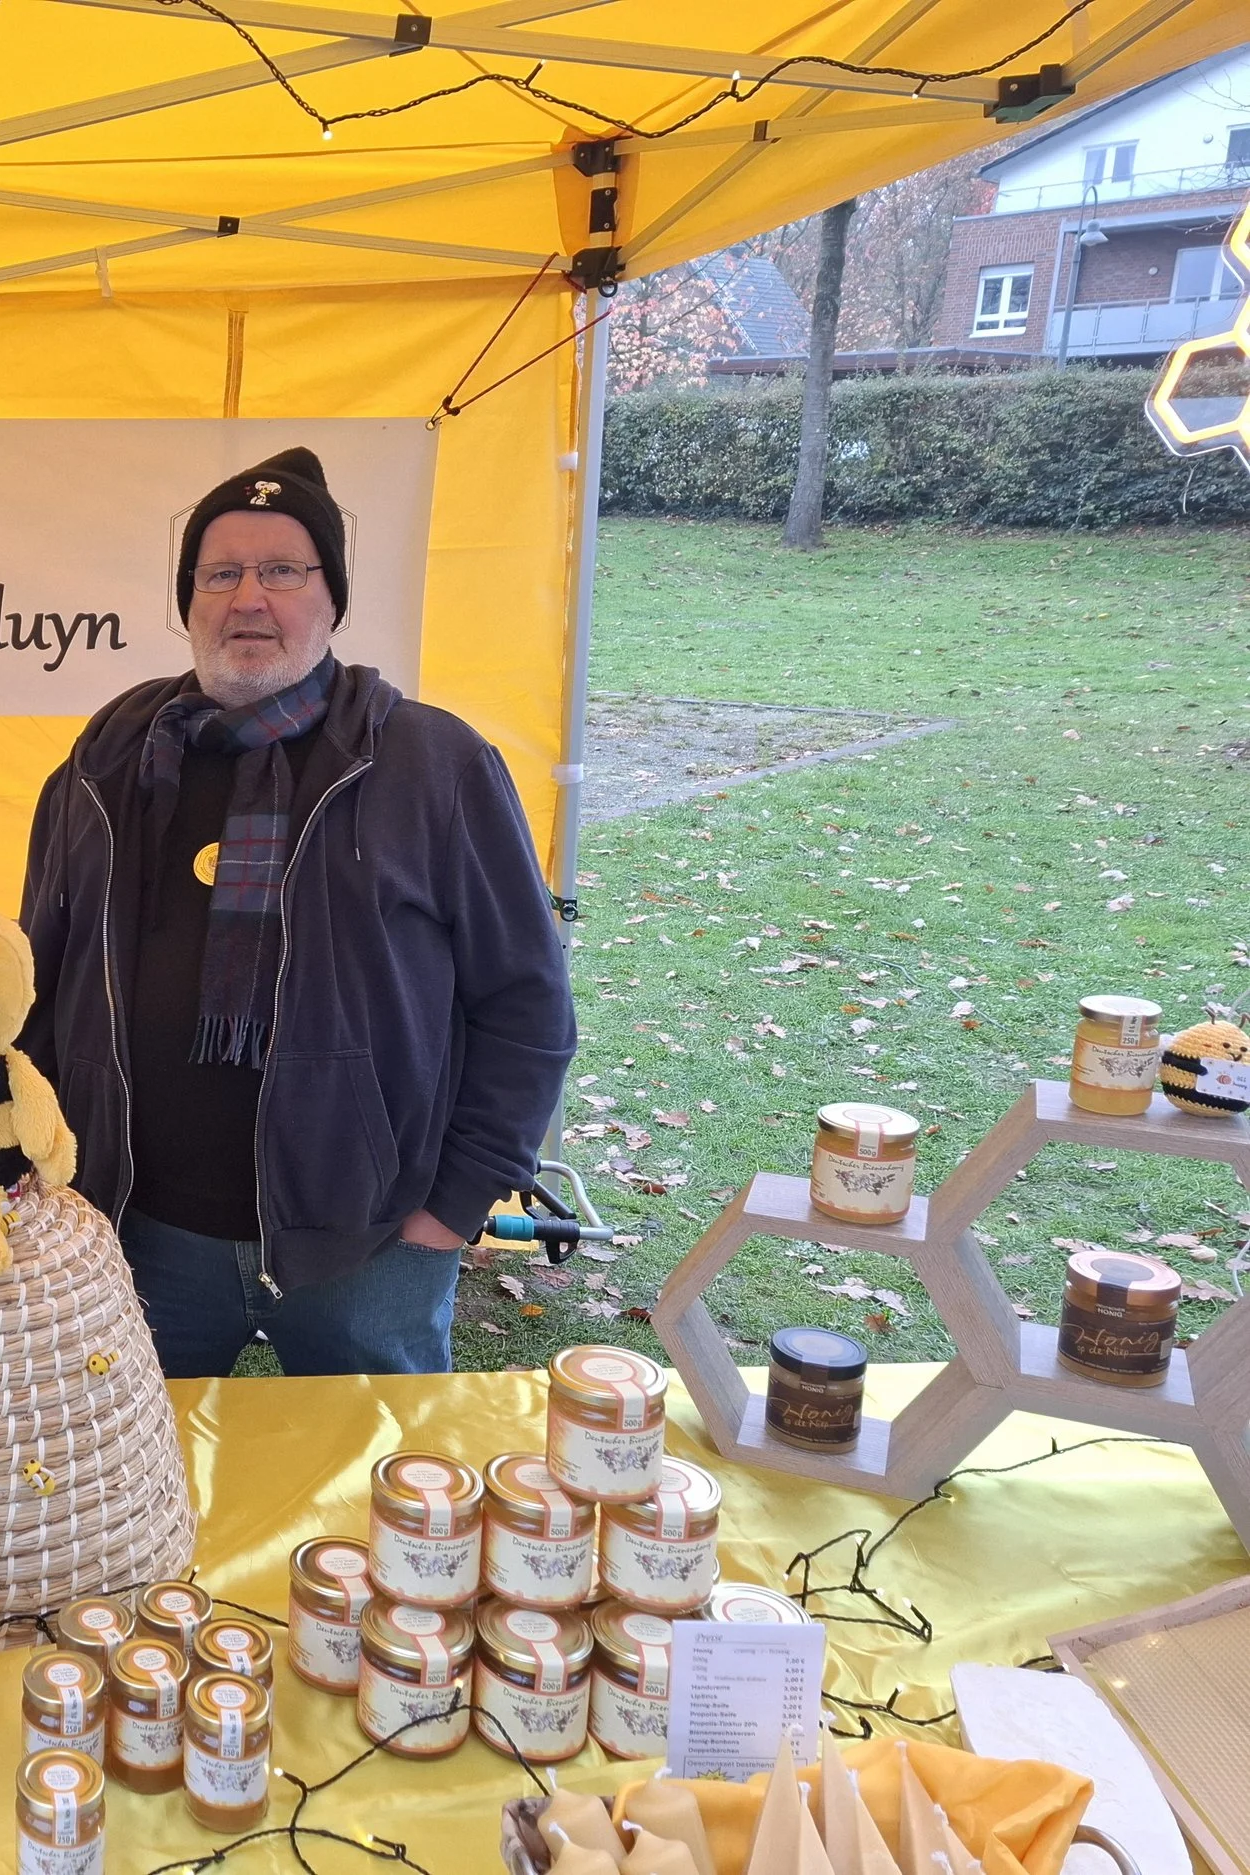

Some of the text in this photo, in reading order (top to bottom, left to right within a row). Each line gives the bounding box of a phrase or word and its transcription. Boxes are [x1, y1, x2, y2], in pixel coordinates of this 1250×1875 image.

[1092, 1045, 1124, 1057] Deutscher
[828, 1154, 905, 1172] Deutscher Bienenhonig
[1097, 1307, 1123, 1318] HONIG
[1061, 1323, 1159, 1353] Honig
[1089, 1345, 1103, 1355] de
[801, 1385, 824, 1394] HONIG
[770, 1396, 854, 1425] Honig
[584, 1431, 626, 1445] Deutscher
[394, 1533, 432, 1551] Deutscher
[512, 1535, 552, 1553] Deutscher
[624, 1533, 664, 1553] Deutscher
[315, 1621, 353, 1638] Deutscher
[390, 1684, 430, 1700] Deutscher
[502, 1686, 542, 1707] Deutscher
[607, 1685, 645, 1710] Deutscher
[132, 1720, 165, 1731] Deutscher
[37, 1733, 69, 1748] Deutscher
[194, 1749, 226, 1771] Deutscher
